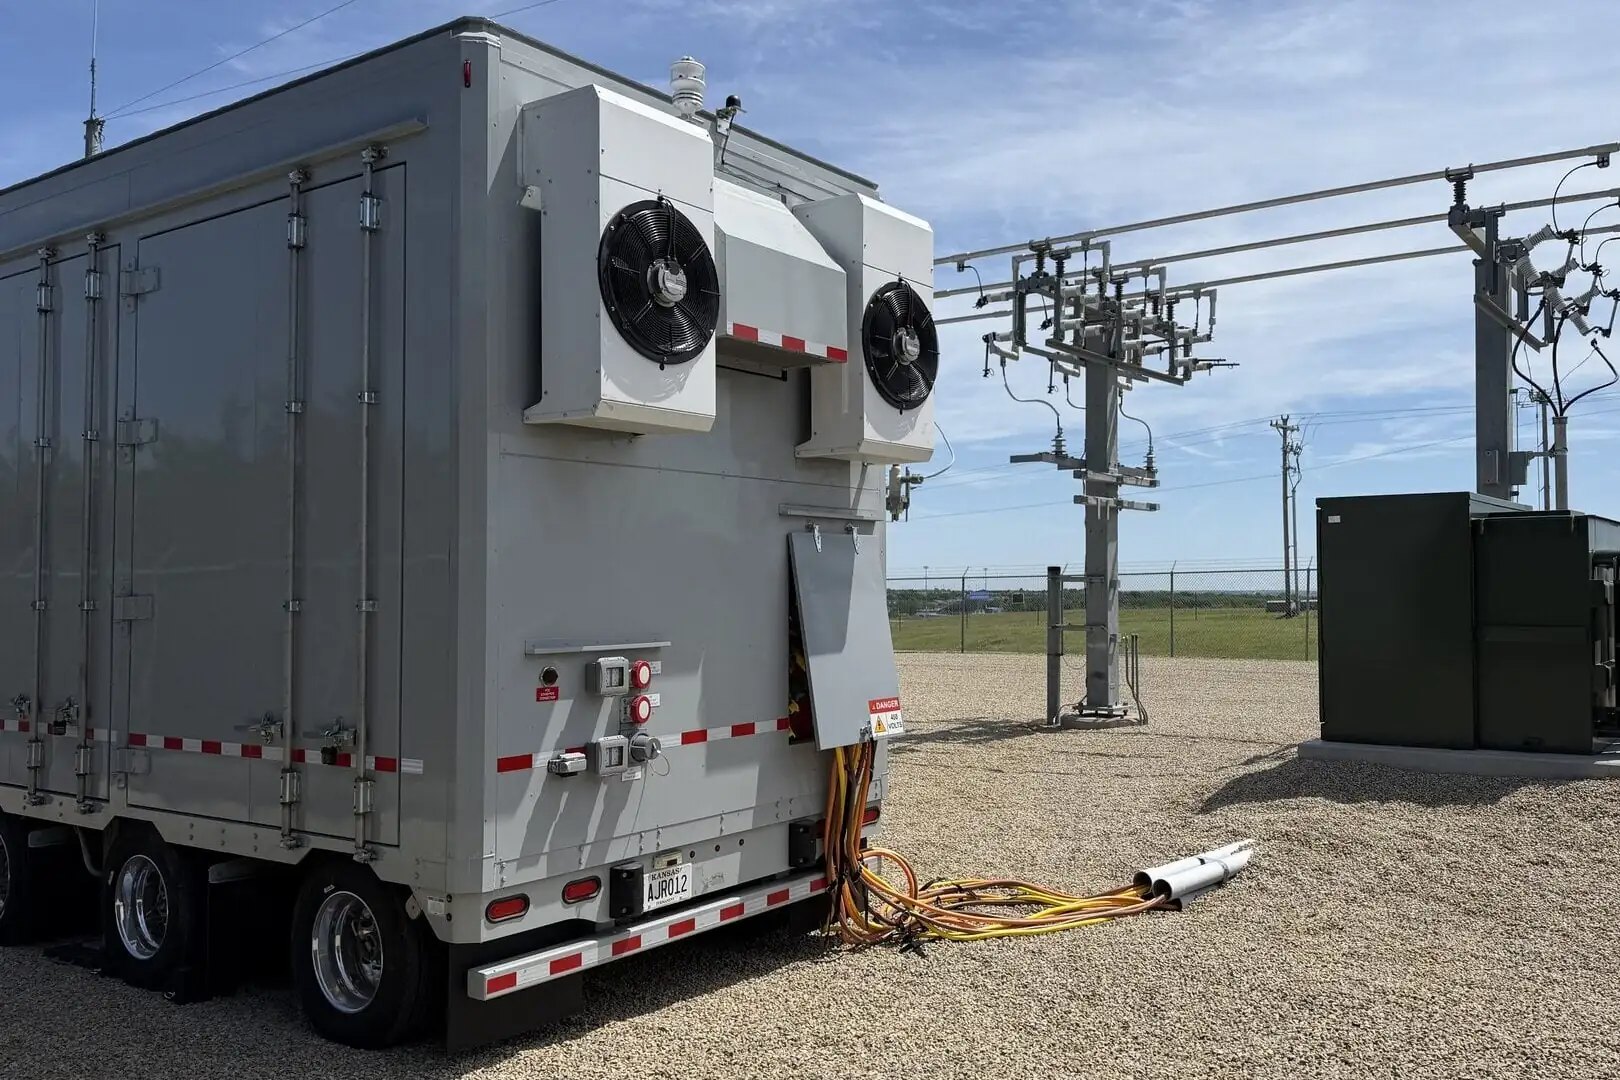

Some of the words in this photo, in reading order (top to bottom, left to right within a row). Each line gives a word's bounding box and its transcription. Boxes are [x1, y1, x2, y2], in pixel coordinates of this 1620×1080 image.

[876, 699, 898, 710] DANGER
[888, 721, 902, 730] VOLTS
[651, 867, 681, 881] KANSAS
[647, 874, 688, 902] AJR012
